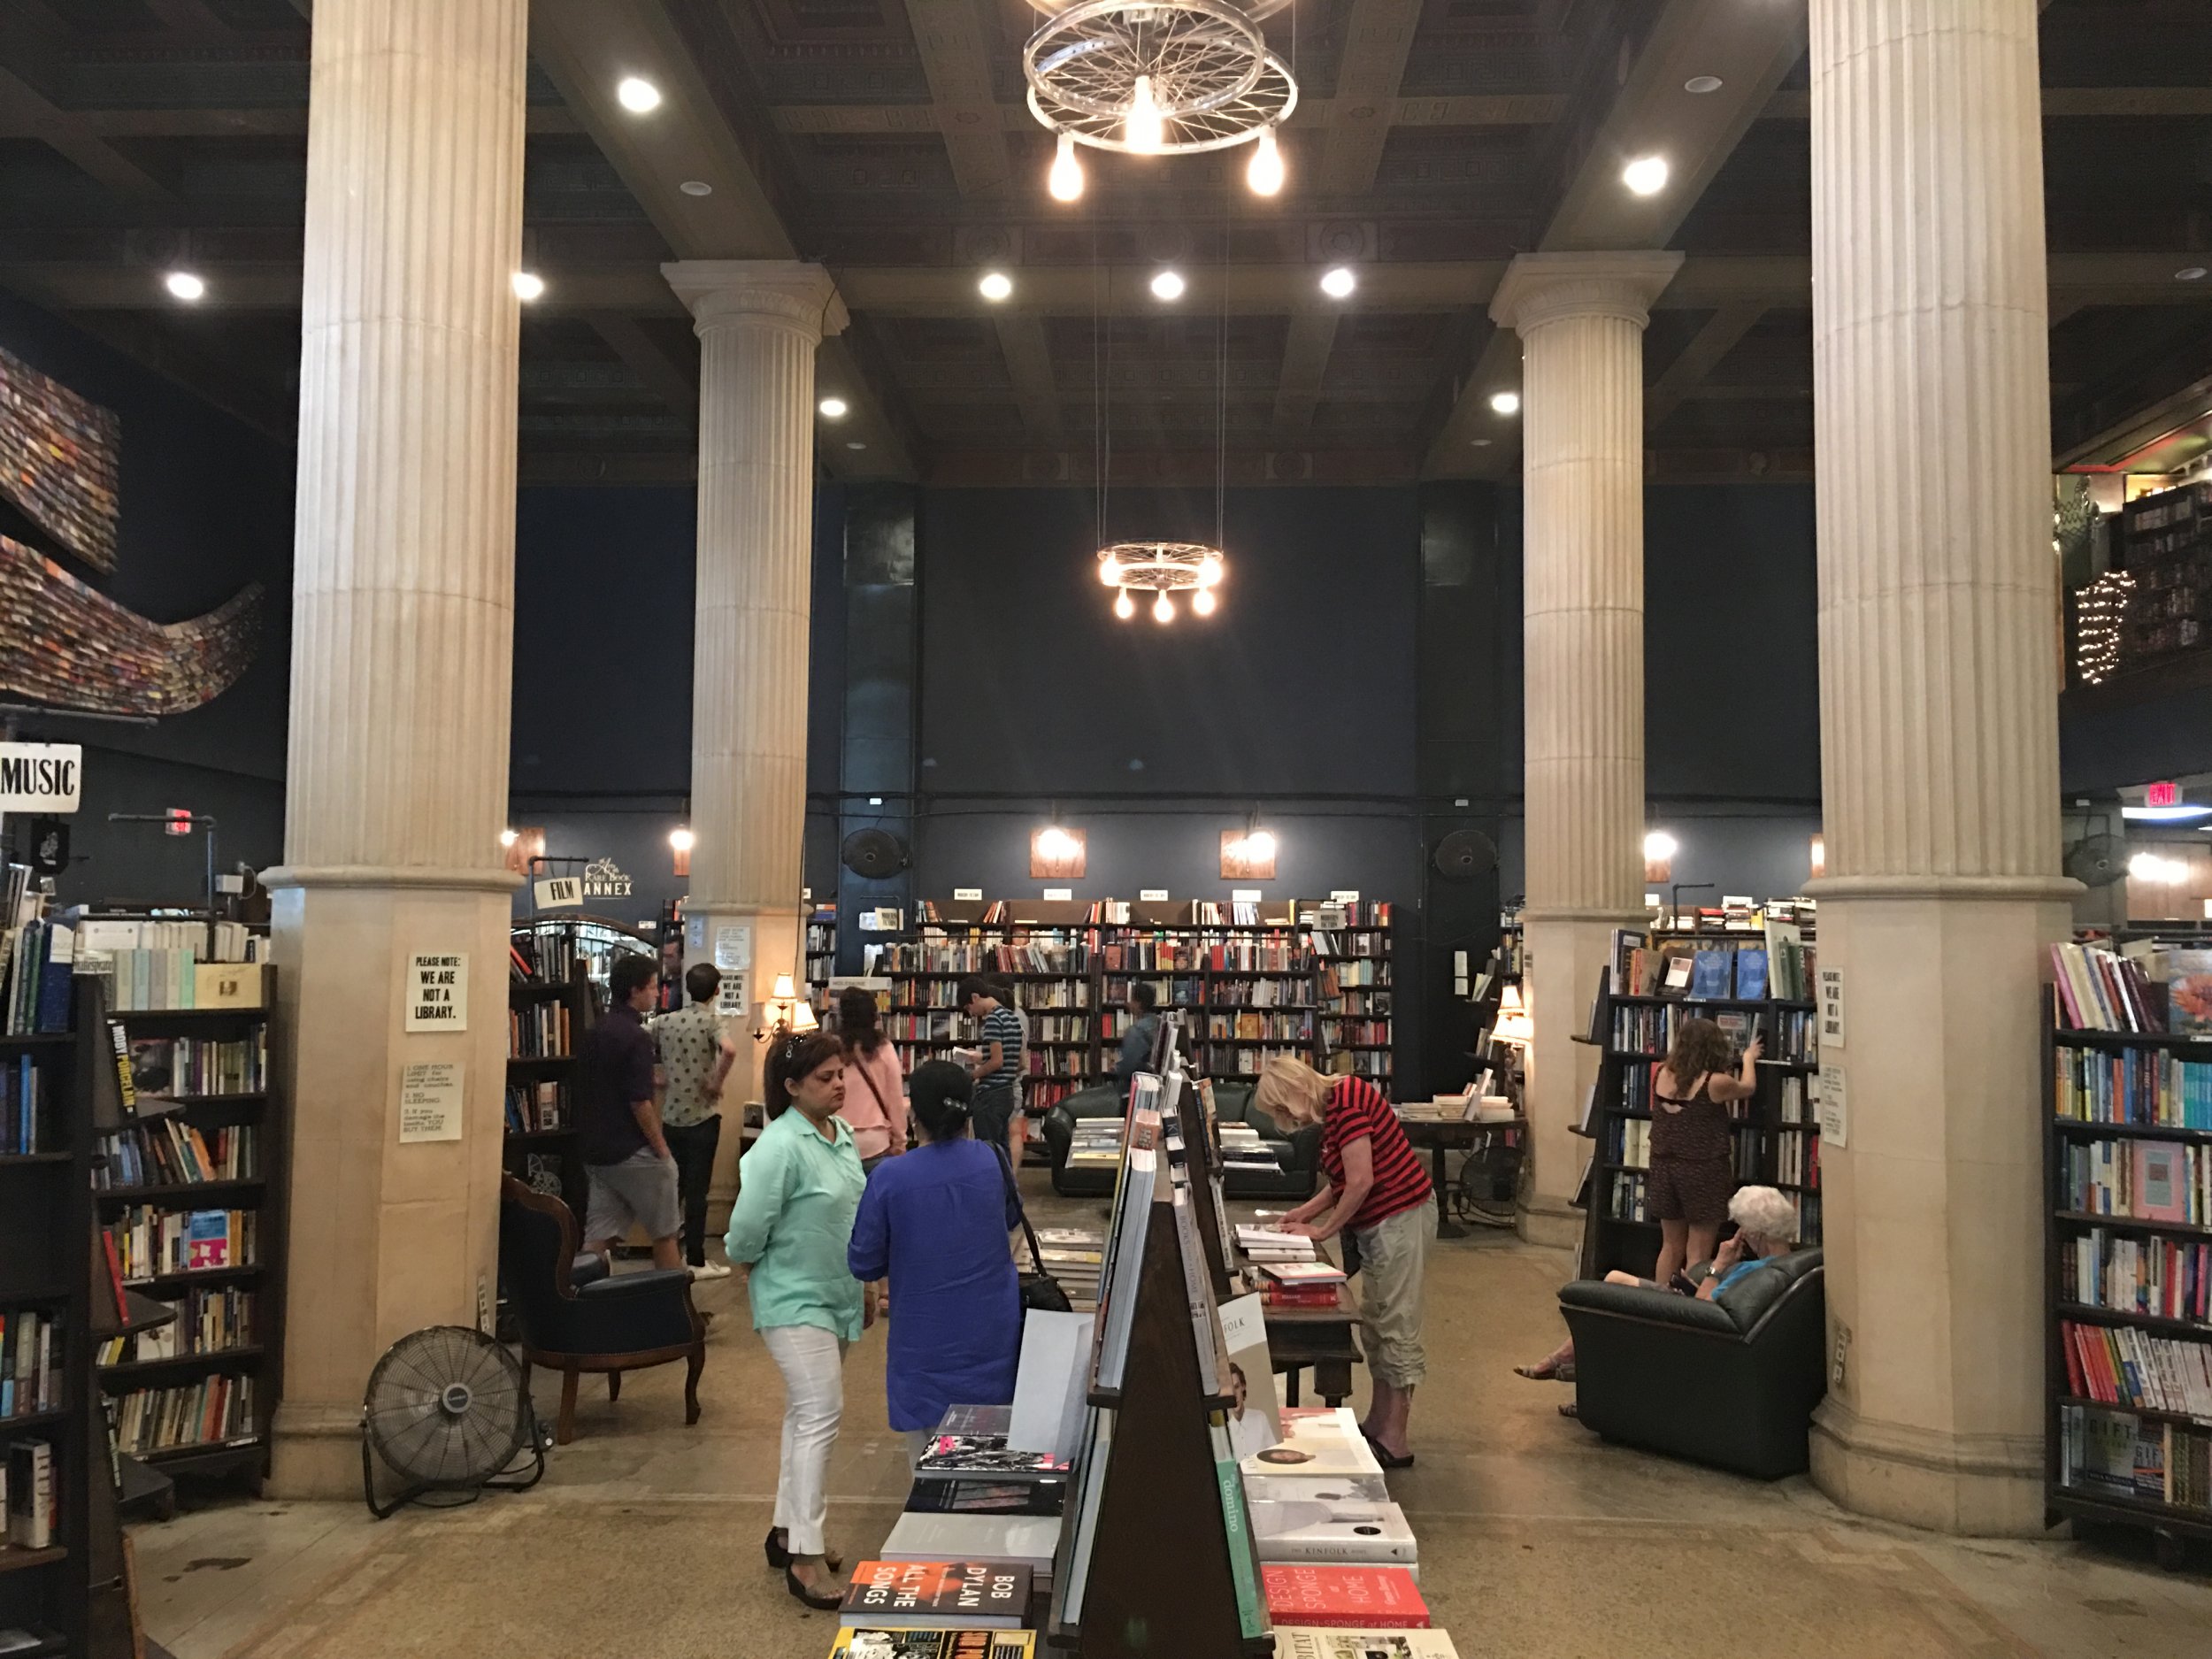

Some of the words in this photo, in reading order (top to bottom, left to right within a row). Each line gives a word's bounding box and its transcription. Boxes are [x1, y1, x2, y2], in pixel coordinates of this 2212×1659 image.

[0, 757, 75, 796] MUSIC
[2149, 783, 2175, 805] EXIT
[549, 880, 574, 901] FILM
[584, 882, 631, 895] ANNEX
[416, 956, 439, 966] PLEASE
[441, 956, 461, 966] NOTE:
[420, 971, 434, 984] WE
[438, 971, 455, 984] ARE
[423, 988, 441, 1002] NOT
[443, 988, 449, 1002] A
[415, 1005, 457, 1019] LIBRARY.
[111, 1025, 127, 1054] MOBY
[116, 1053, 134, 1107] PORCELAIN
[1179, 1216, 1190, 1245] BOOKS
[1223, 1479, 1239, 1532] domino
[1305, 1547, 1348, 1555] KINFOLK
[902, 1564, 927, 1582] ALL
[864, 1566, 897, 1605] SONGS
[894, 1586, 920, 1607] THE
[957, 1567, 987, 1607] DYLAN
[990, 1575, 1015, 1599] BOB
[1266, 1570, 1294, 1607] DESIGN
[1294, 1569, 1326, 1609] SPONGE
[1342, 1575, 1372, 1604] HOME
[1380, 1620, 1408, 1629] HOME
